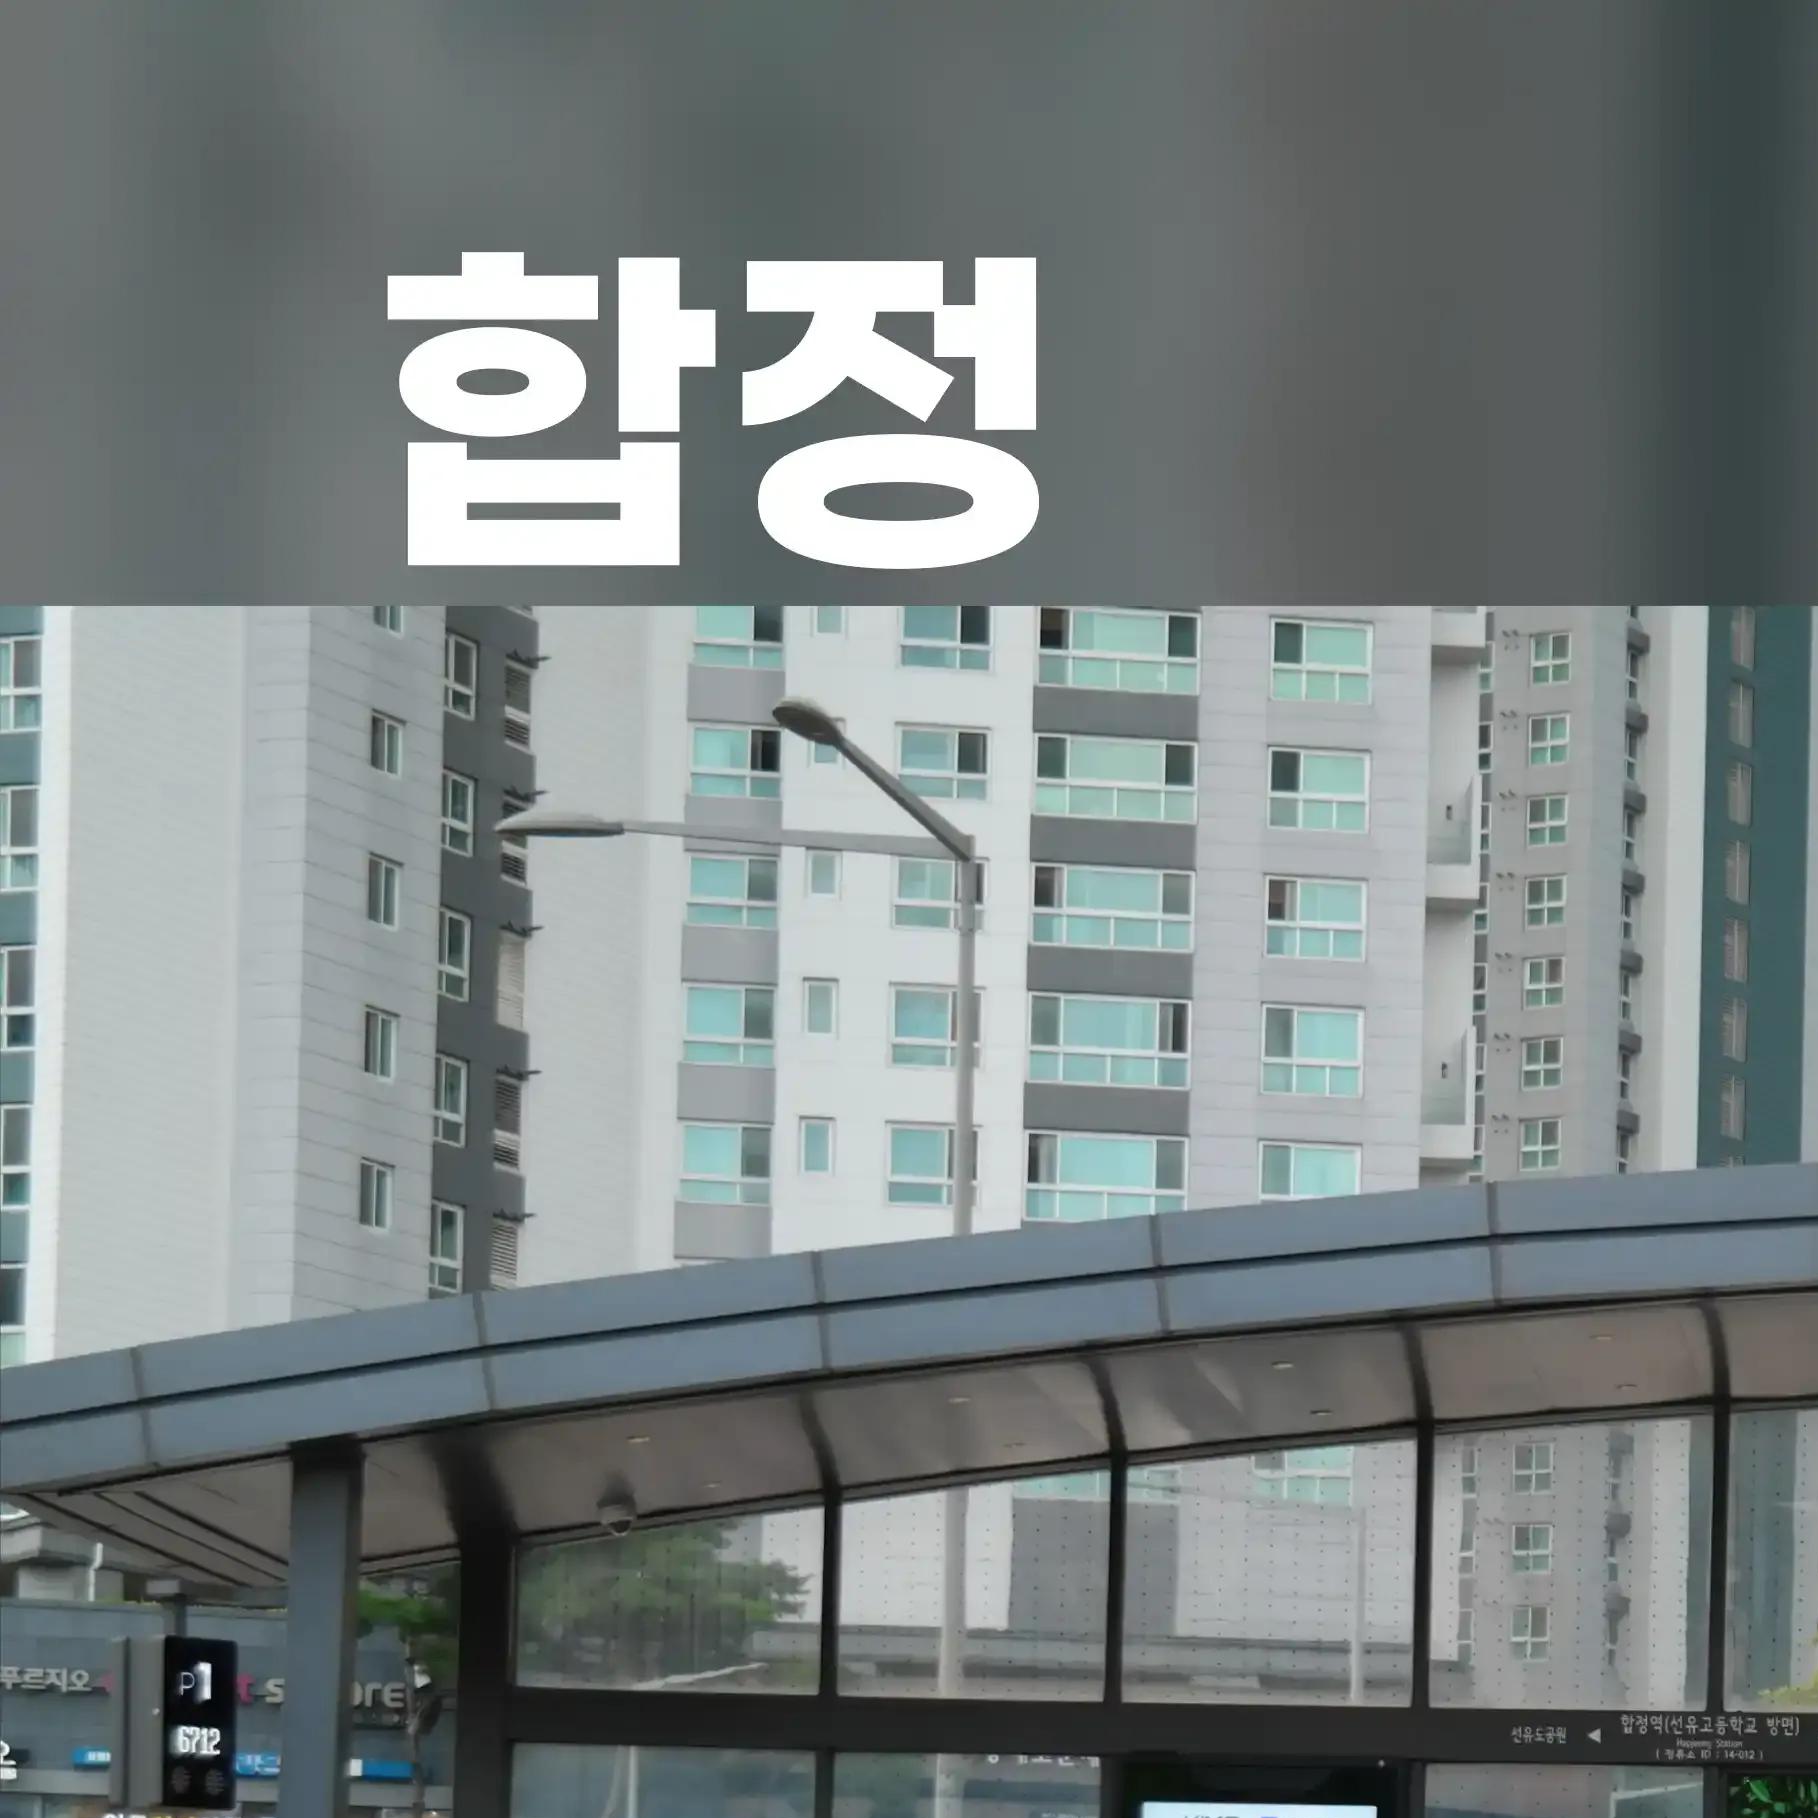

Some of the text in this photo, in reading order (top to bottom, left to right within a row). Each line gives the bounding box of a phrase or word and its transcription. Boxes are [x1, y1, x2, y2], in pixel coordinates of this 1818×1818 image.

[0, 1666, 92, 1693] 푸르지오
[1510, 1726, 1567, 1744] 선유도공원
[1620, 1714, 1801, 1737] 합정역(선유고등학교 방면)
[176, 1726, 221, 1755] 6712
